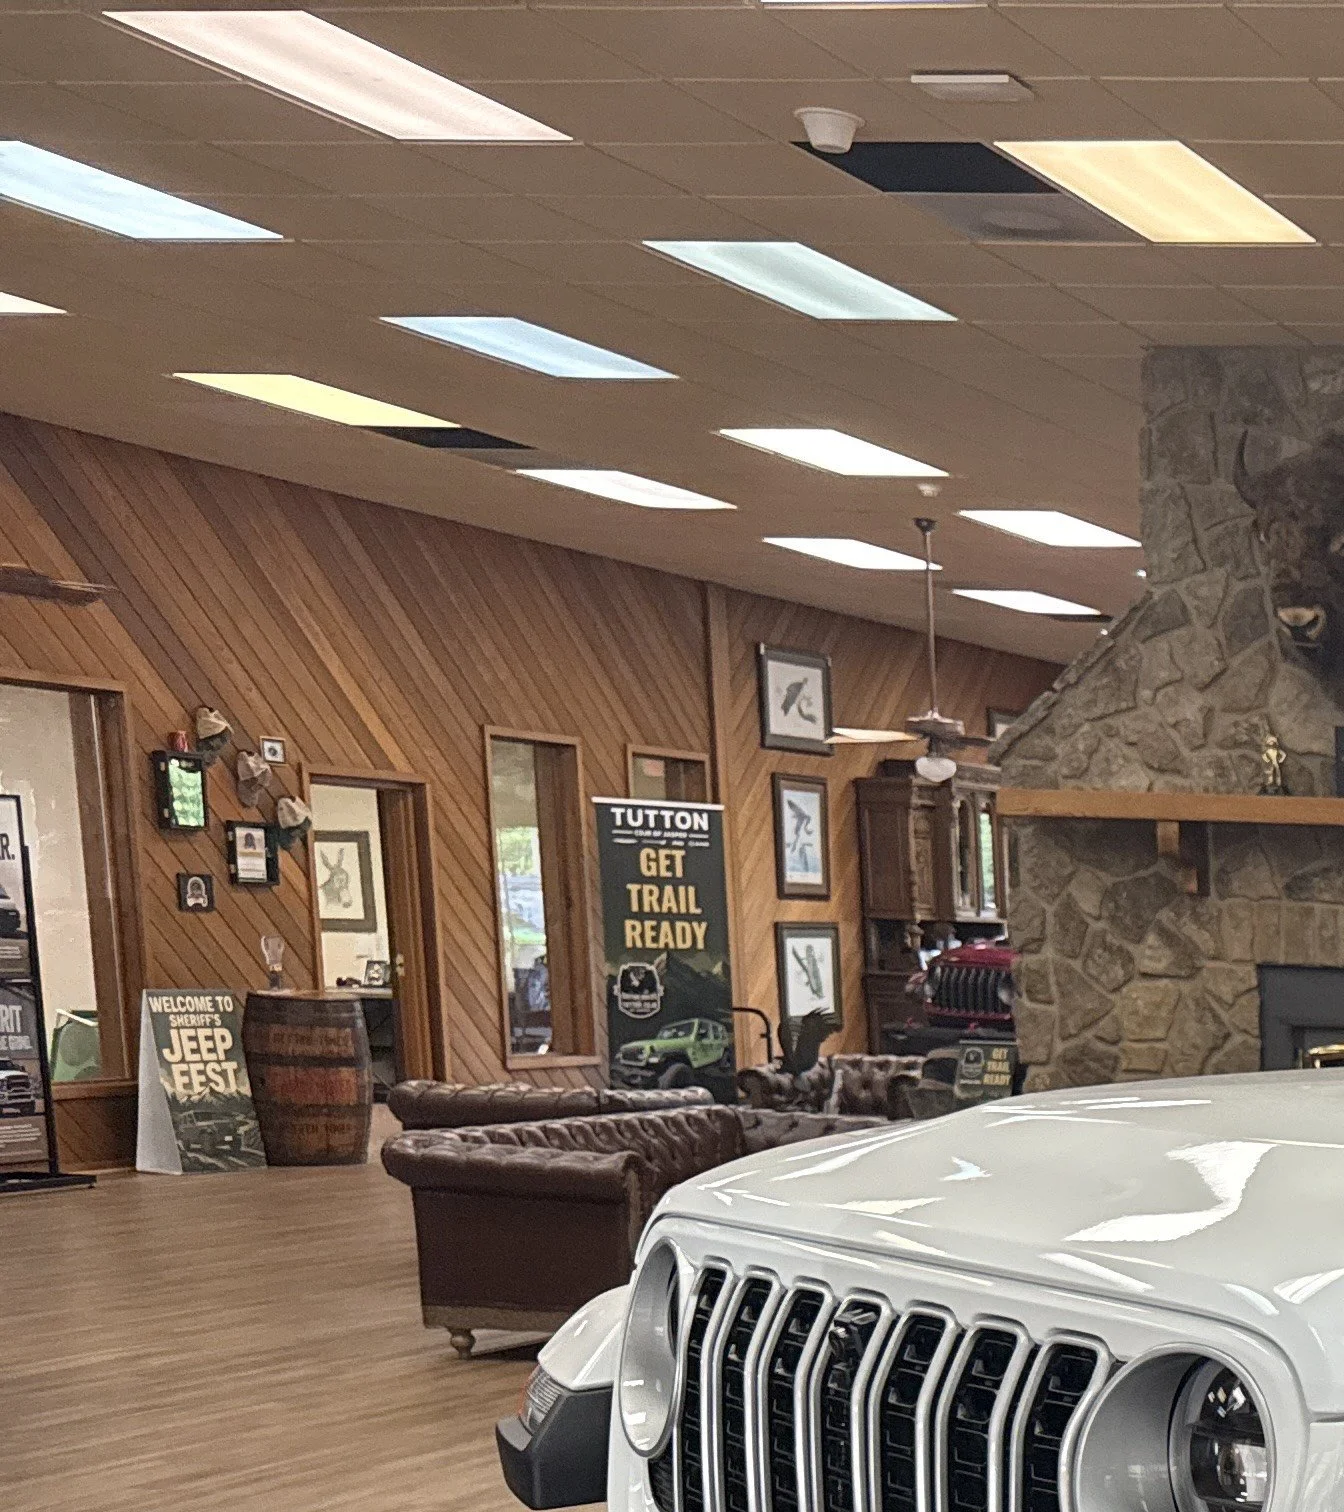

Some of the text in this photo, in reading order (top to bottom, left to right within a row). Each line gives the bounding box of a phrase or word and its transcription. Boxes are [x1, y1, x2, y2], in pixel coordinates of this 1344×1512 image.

[610, 807, 709, 831] TUTTON
[639, 847, 686, 878] GET
[625, 883, 703, 915] TRAIL
[623, 919, 708, 950] READY
[148, 996, 234, 1013] WELCOME TO
[169, 1013, 222, 1028] SHERIFF'S
[162, 1028, 233, 1063] JEEP
[171, 1062, 238, 1095] FEST
